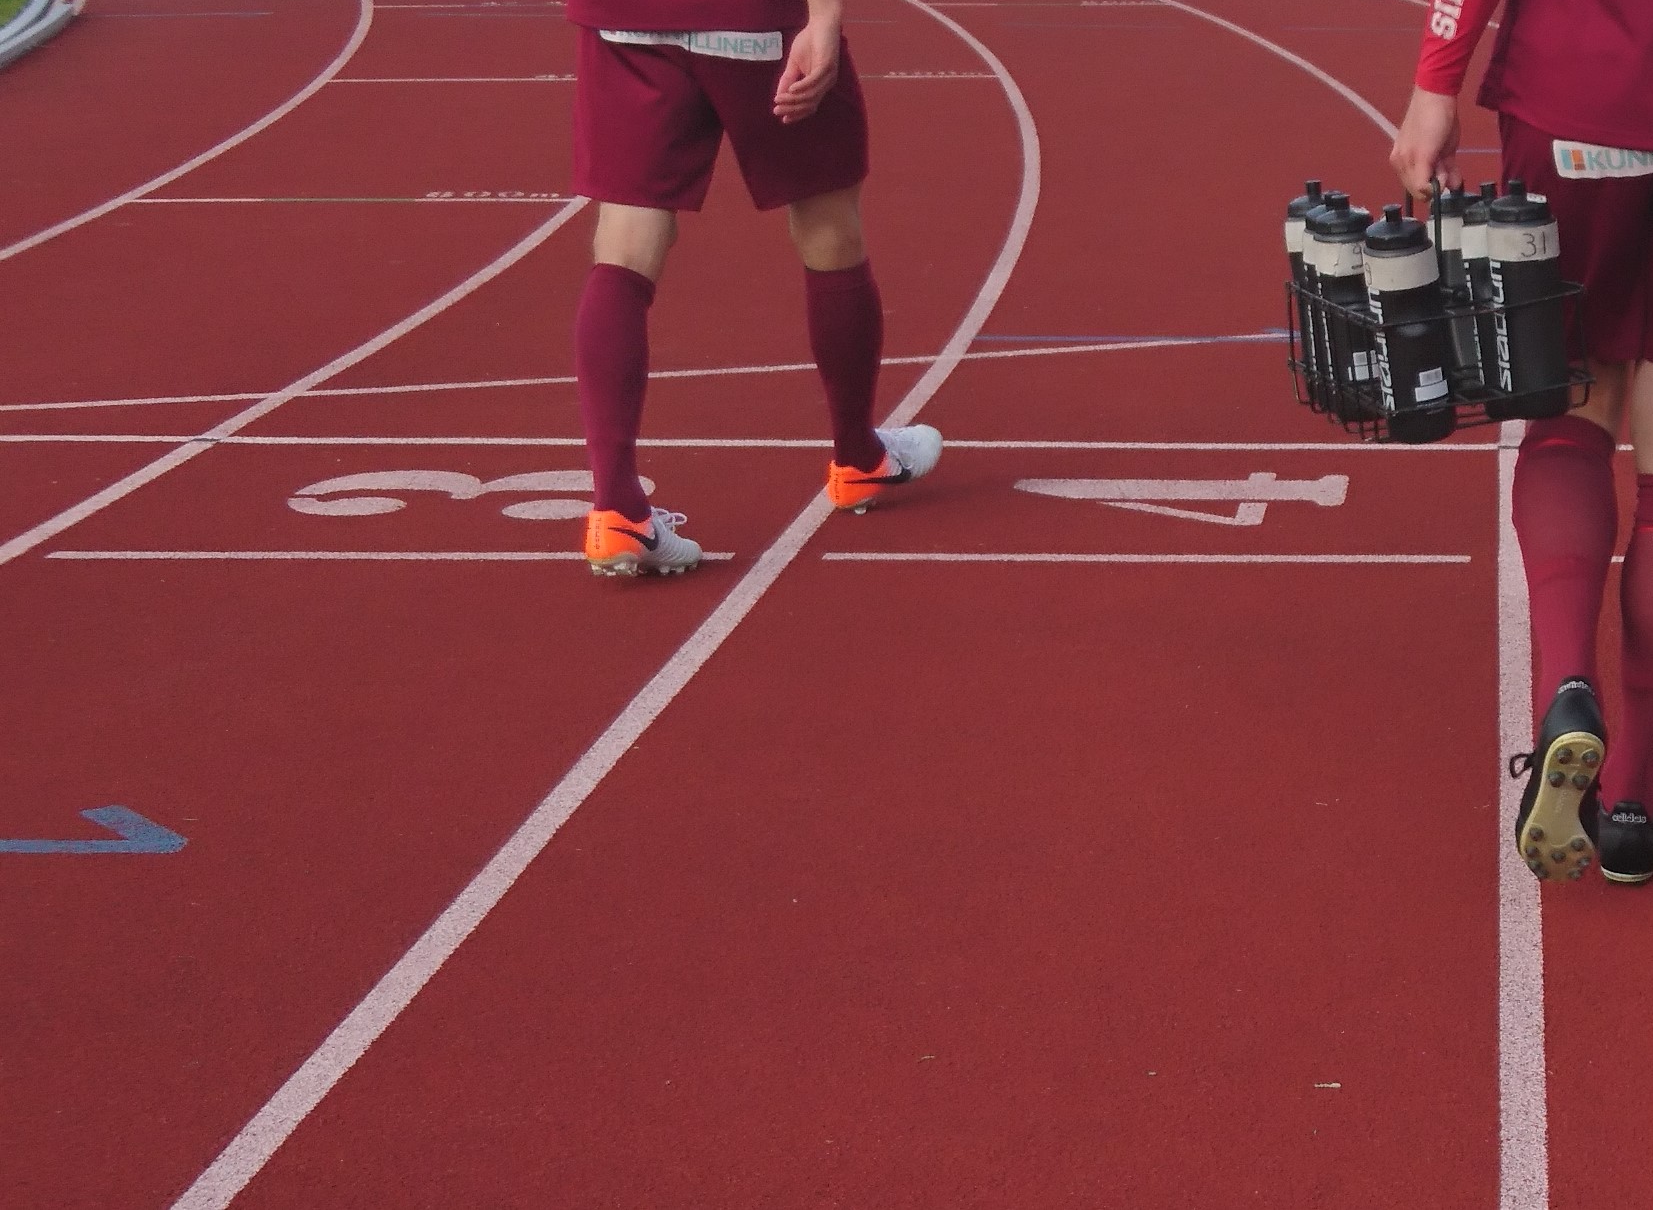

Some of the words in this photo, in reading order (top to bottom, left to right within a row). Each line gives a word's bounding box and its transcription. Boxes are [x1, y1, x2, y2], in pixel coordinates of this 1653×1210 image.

[1521, 231, 1546, 258] 31
[287, 470, 656, 520] 3
[1014, 472, 1349, 525] 4
